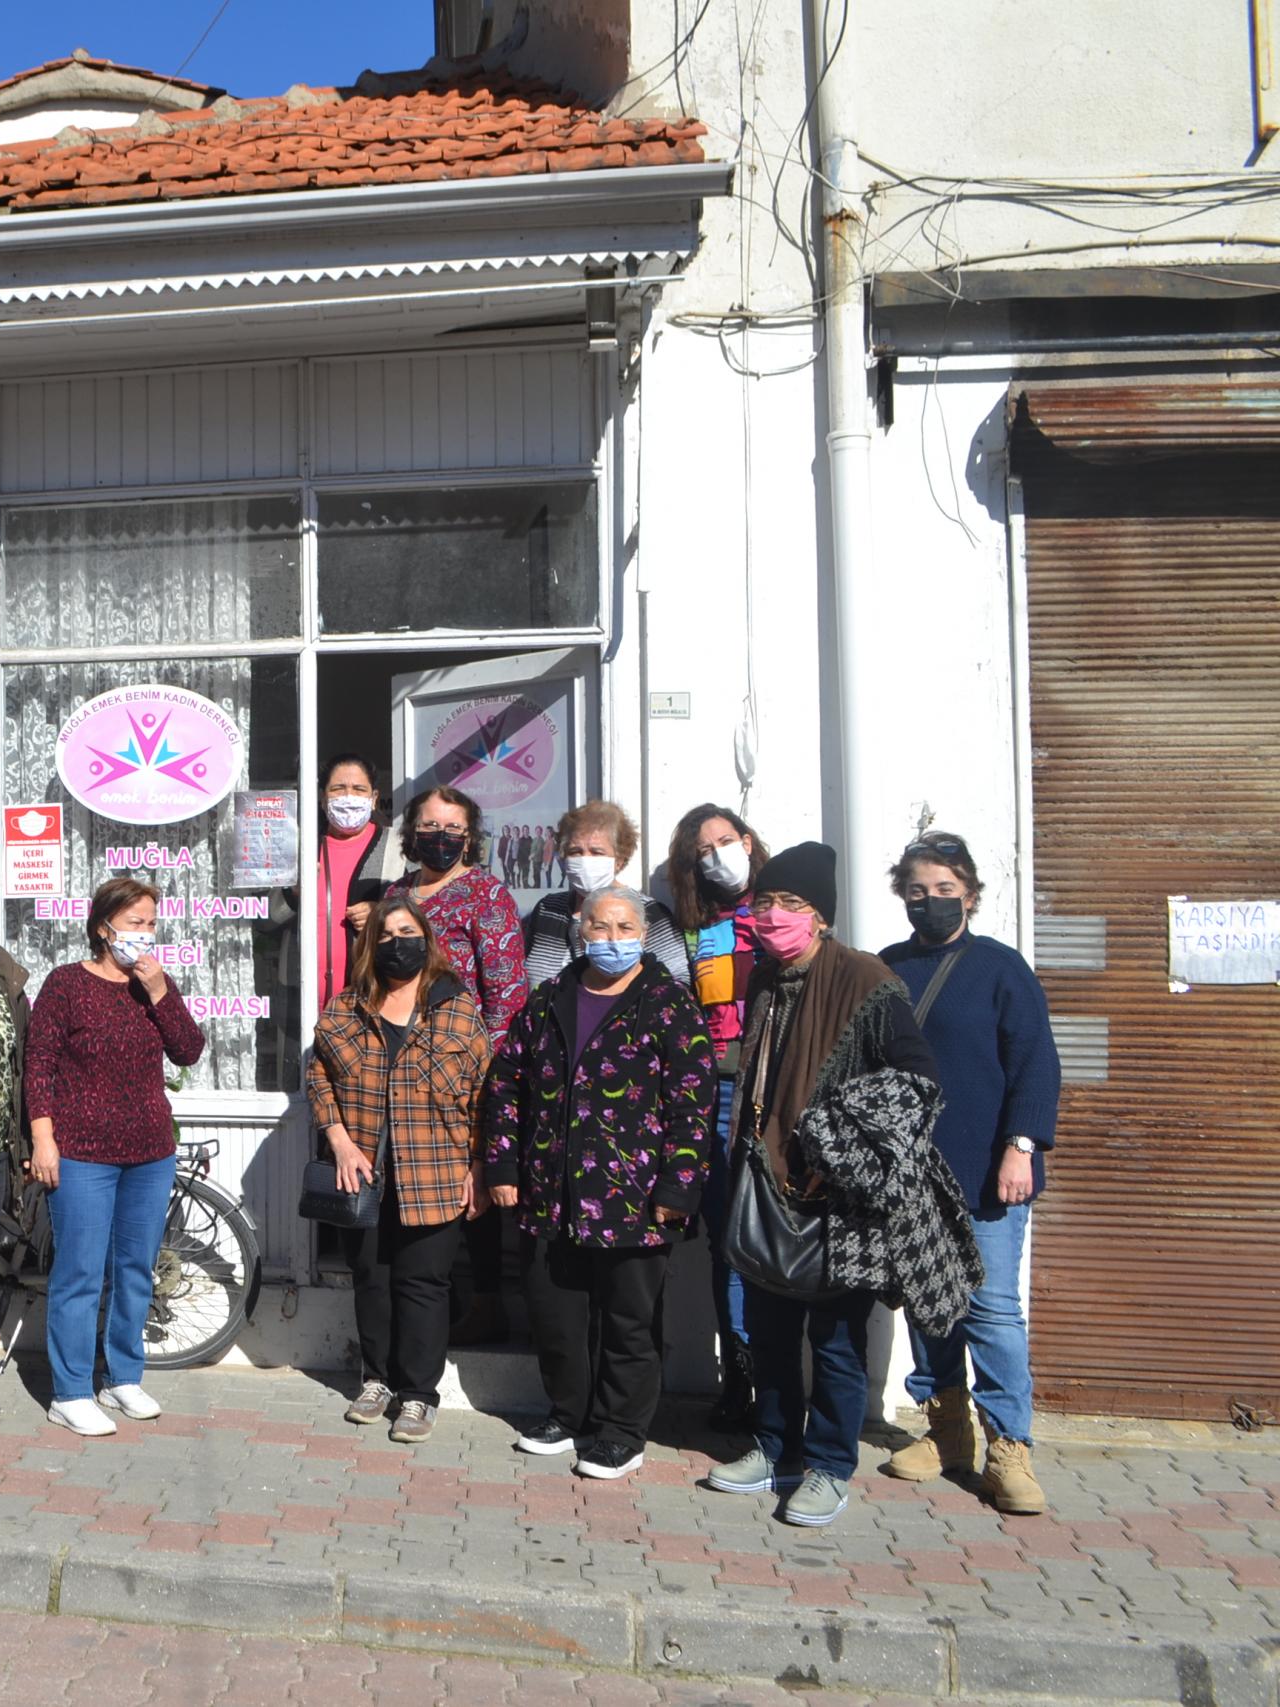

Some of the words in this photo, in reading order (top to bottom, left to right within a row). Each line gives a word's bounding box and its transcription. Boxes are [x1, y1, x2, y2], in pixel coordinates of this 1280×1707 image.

[451, 701, 473, 719] EMEK
[666, 696, 673, 707] 1
[59, 709, 91, 743] MUĞLA
[92, 694, 122, 712] EMEK
[126, 689, 160, 700] BENİM
[164, 692, 198, 708] KADIN
[200, 704, 241, 745] DERNEĞİ
[22, 849, 44, 858] İÇERİ
[107, 842, 193, 868] MUĞLA
[13, 860, 53, 869] MASKESİZ
[18, 871, 49, 880] GİRMEK
[14, 883, 54, 891] YASAKTIR
[193, 898, 268, 917] KADIN
[1175, 905, 1265, 928] KARŞIYA
[156, 941, 202, 964] NEĞİ
[186, 997, 268, 1020] IŞMASI
